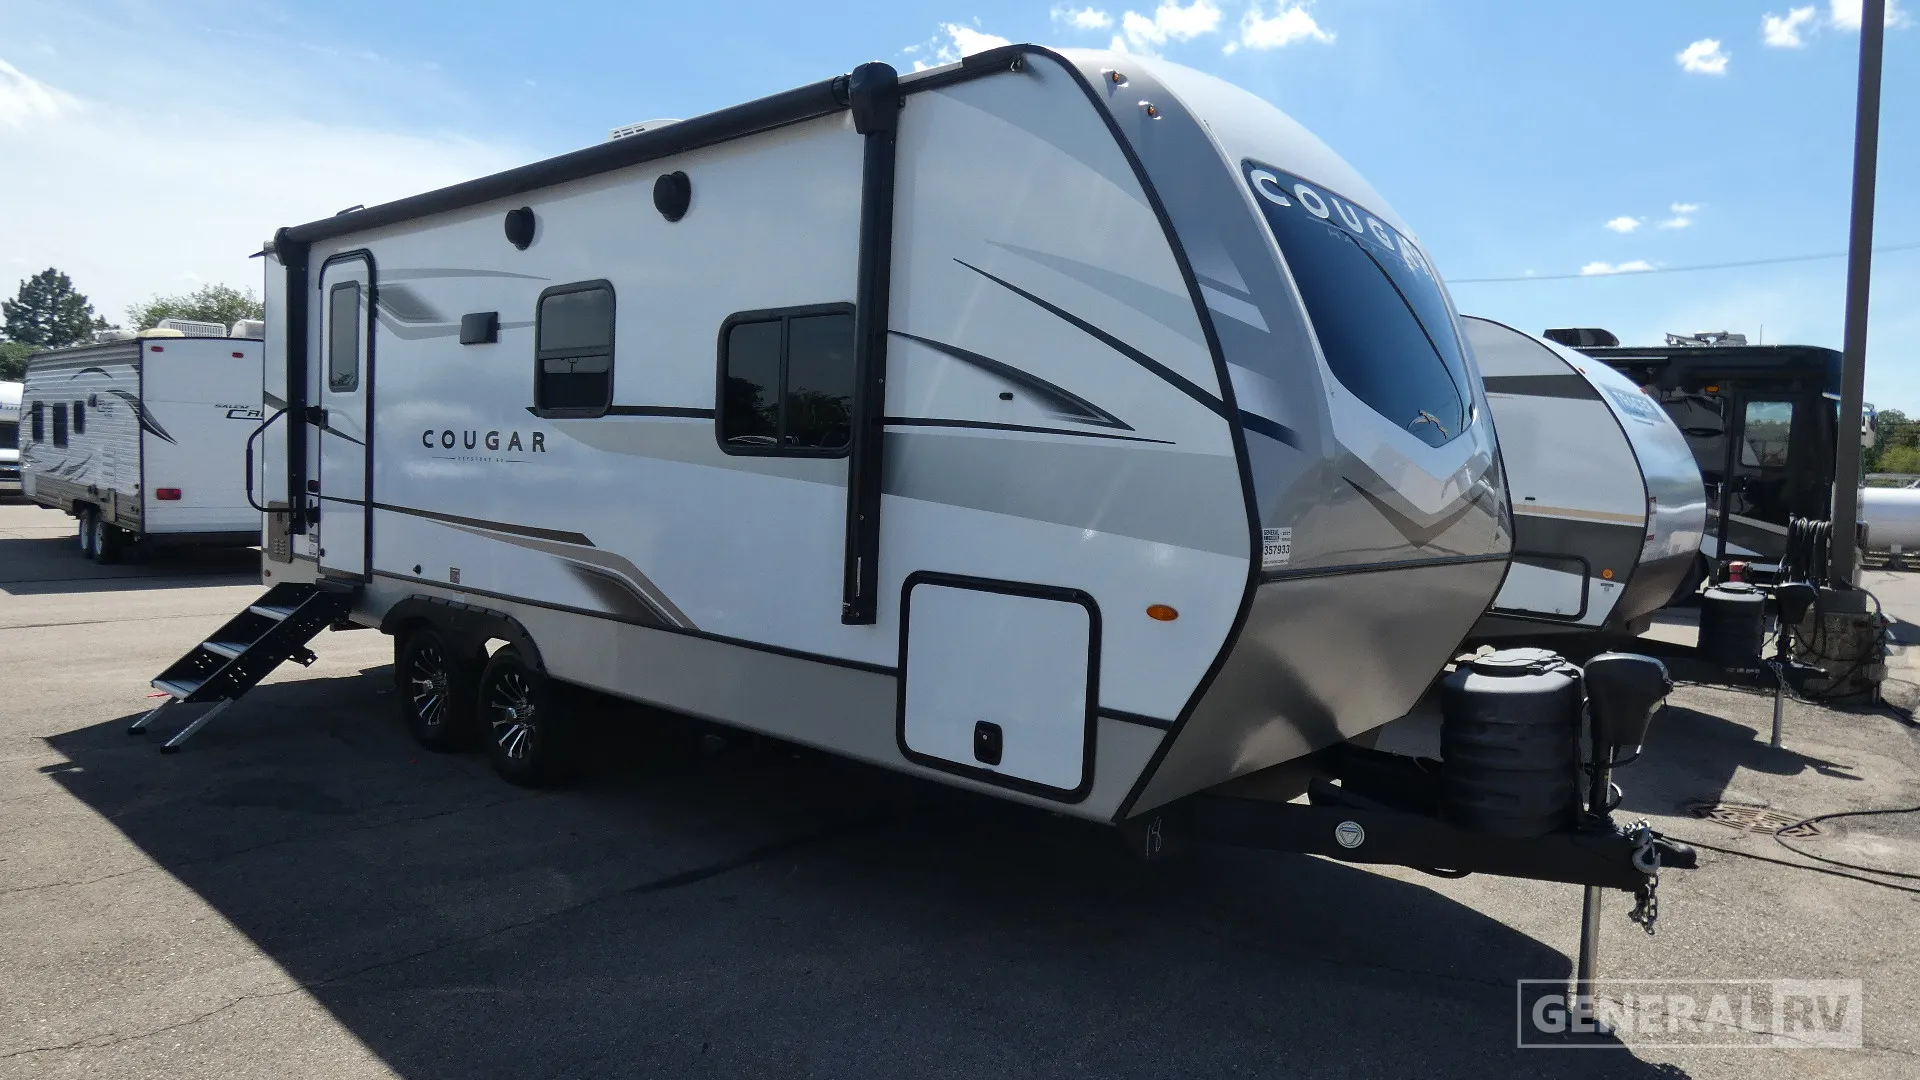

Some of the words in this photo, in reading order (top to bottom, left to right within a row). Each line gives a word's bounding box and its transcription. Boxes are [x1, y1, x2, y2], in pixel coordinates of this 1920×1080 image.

[226, 409, 264, 420] CR
[422, 429, 546, 453] COUGAR
[1264, 545, 1290, 555] 357933
